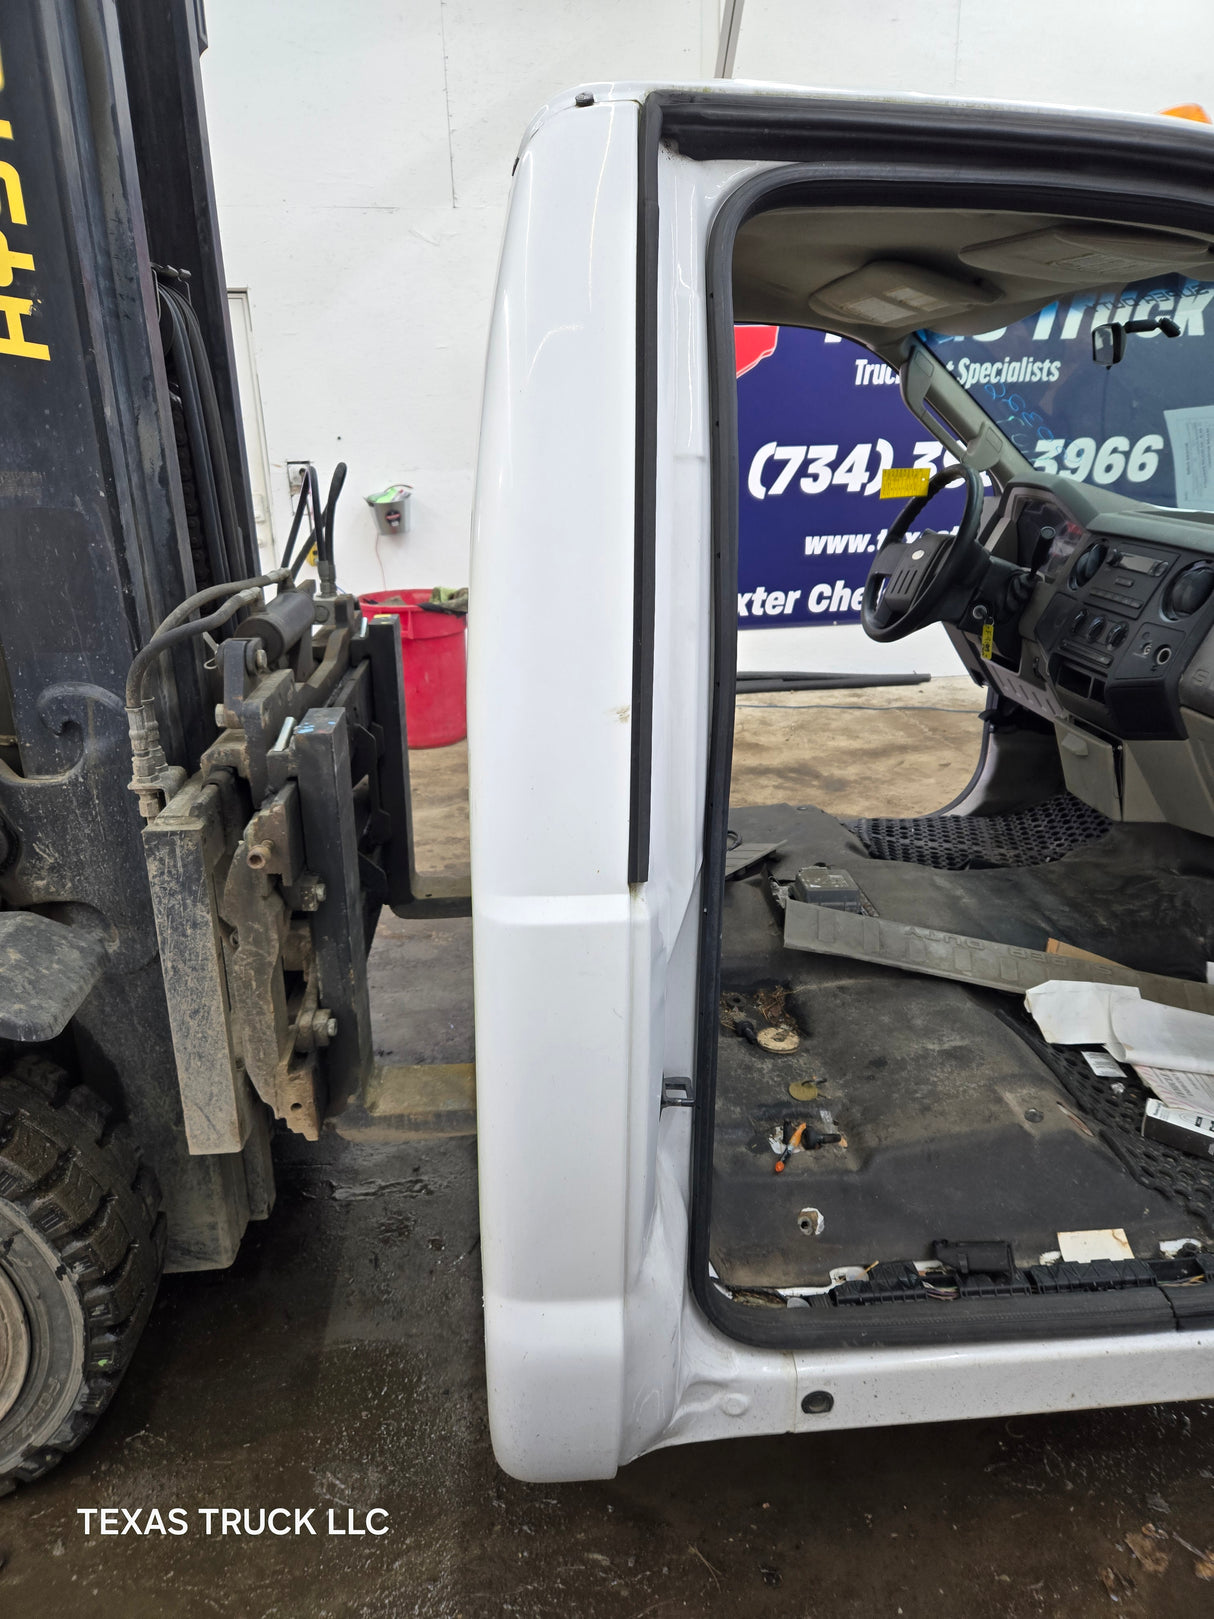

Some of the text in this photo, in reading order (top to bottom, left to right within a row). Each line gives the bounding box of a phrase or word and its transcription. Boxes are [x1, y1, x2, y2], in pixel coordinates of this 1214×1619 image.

[855, 356, 1062, 389] Truc Specialists
[747, 438, 894, 500] (734)
